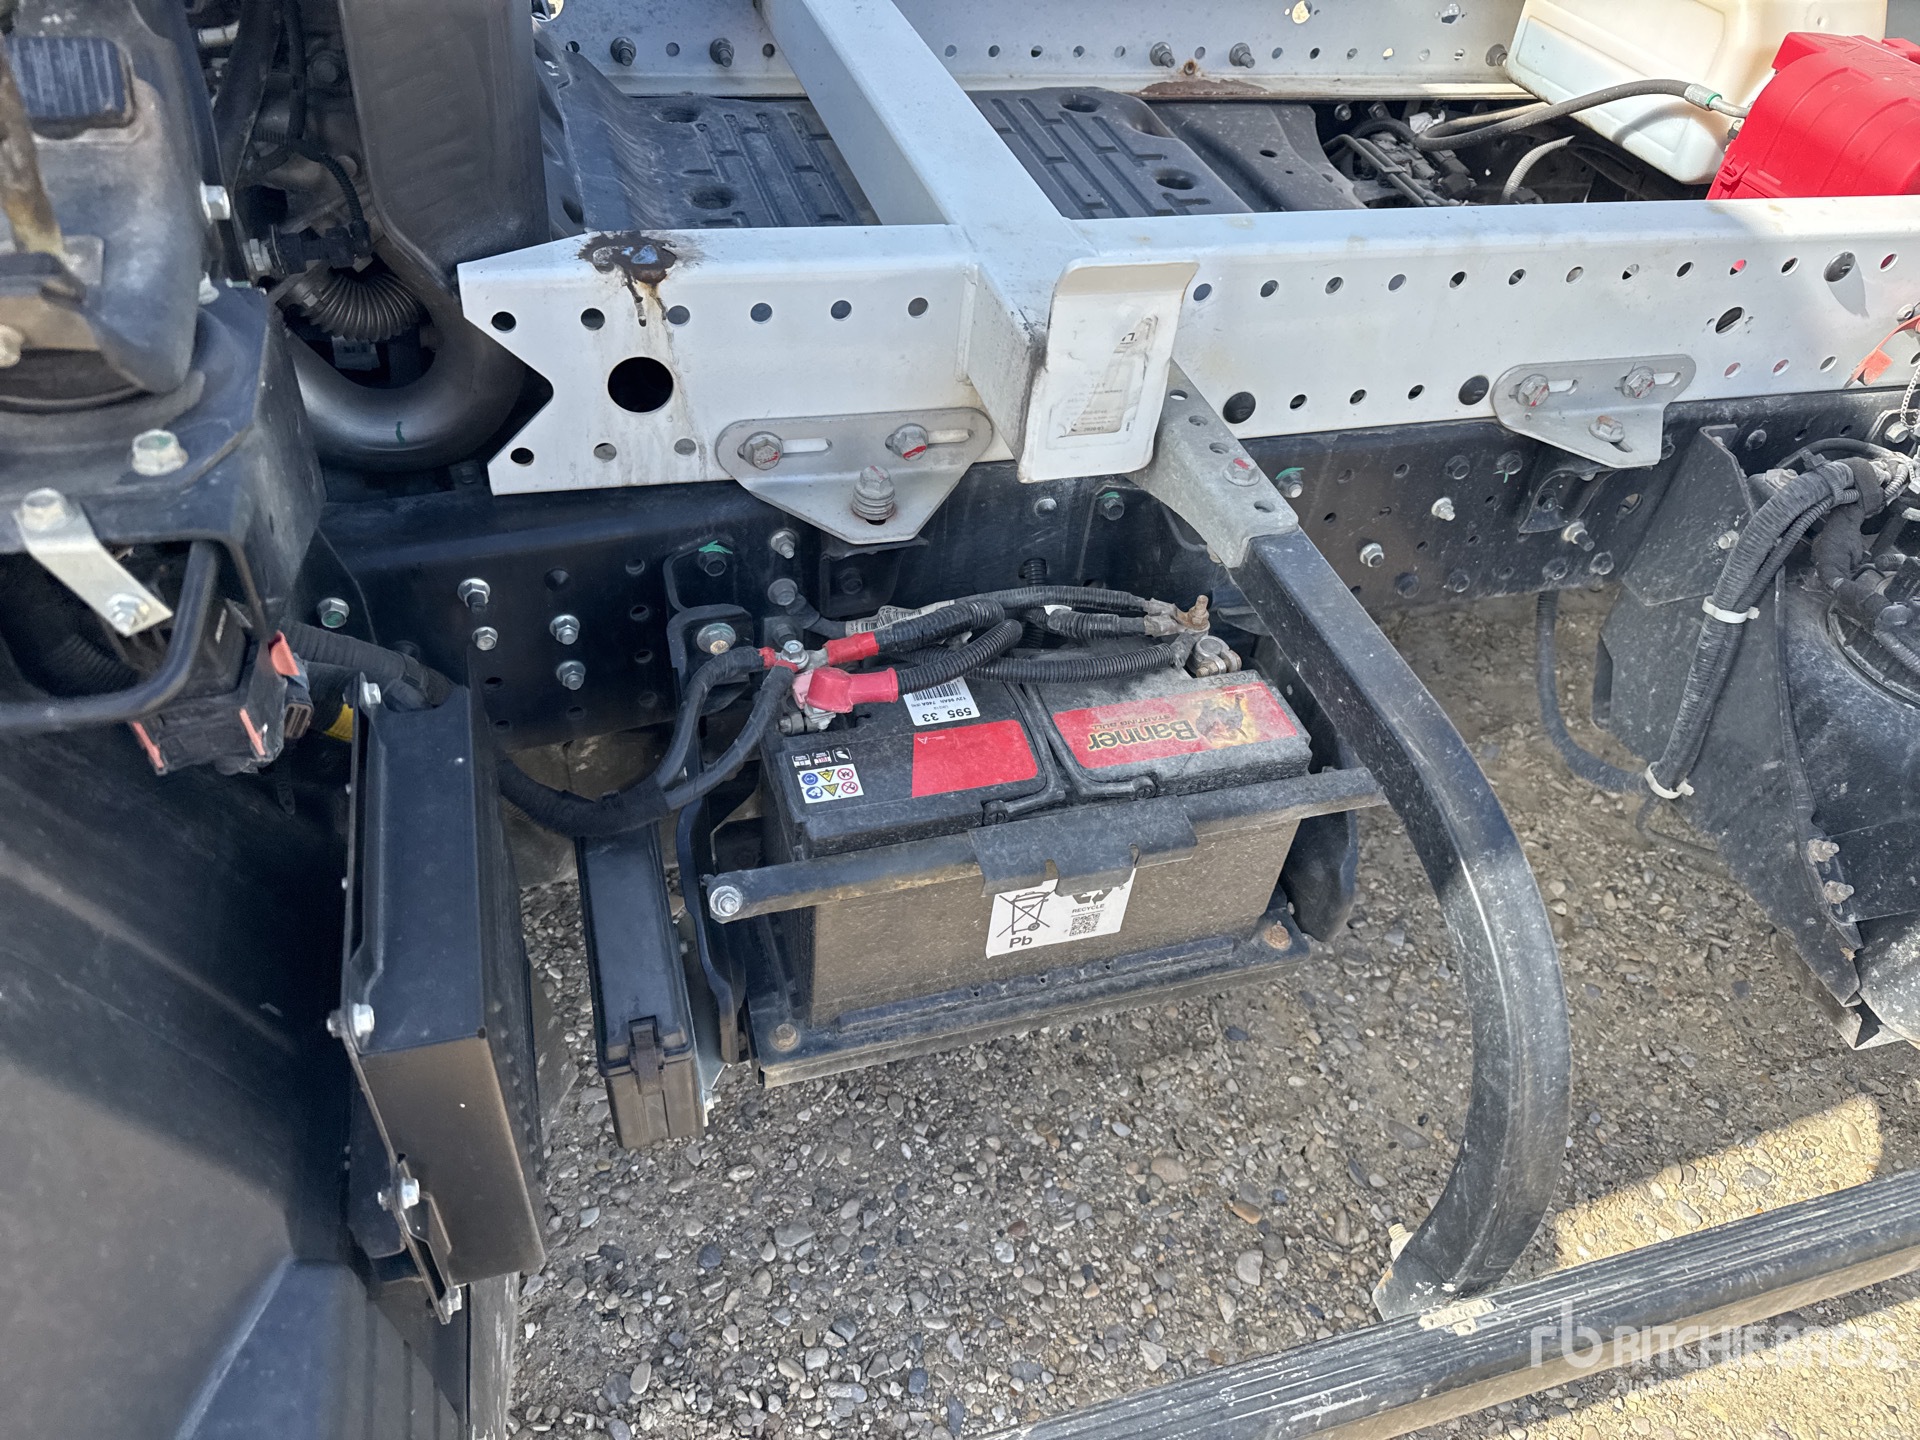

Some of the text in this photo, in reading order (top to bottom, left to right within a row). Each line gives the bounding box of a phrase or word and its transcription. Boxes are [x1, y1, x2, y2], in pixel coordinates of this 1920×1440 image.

[921, 707, 972, 722] 595 33
[1091, 714, 1170, 730] STARTING BULL
[1087, 719, 1197, 751] Banner
[1071, 903, 1105, 913] RECYCLE
[1009, 935, 1033, 949] Pb
